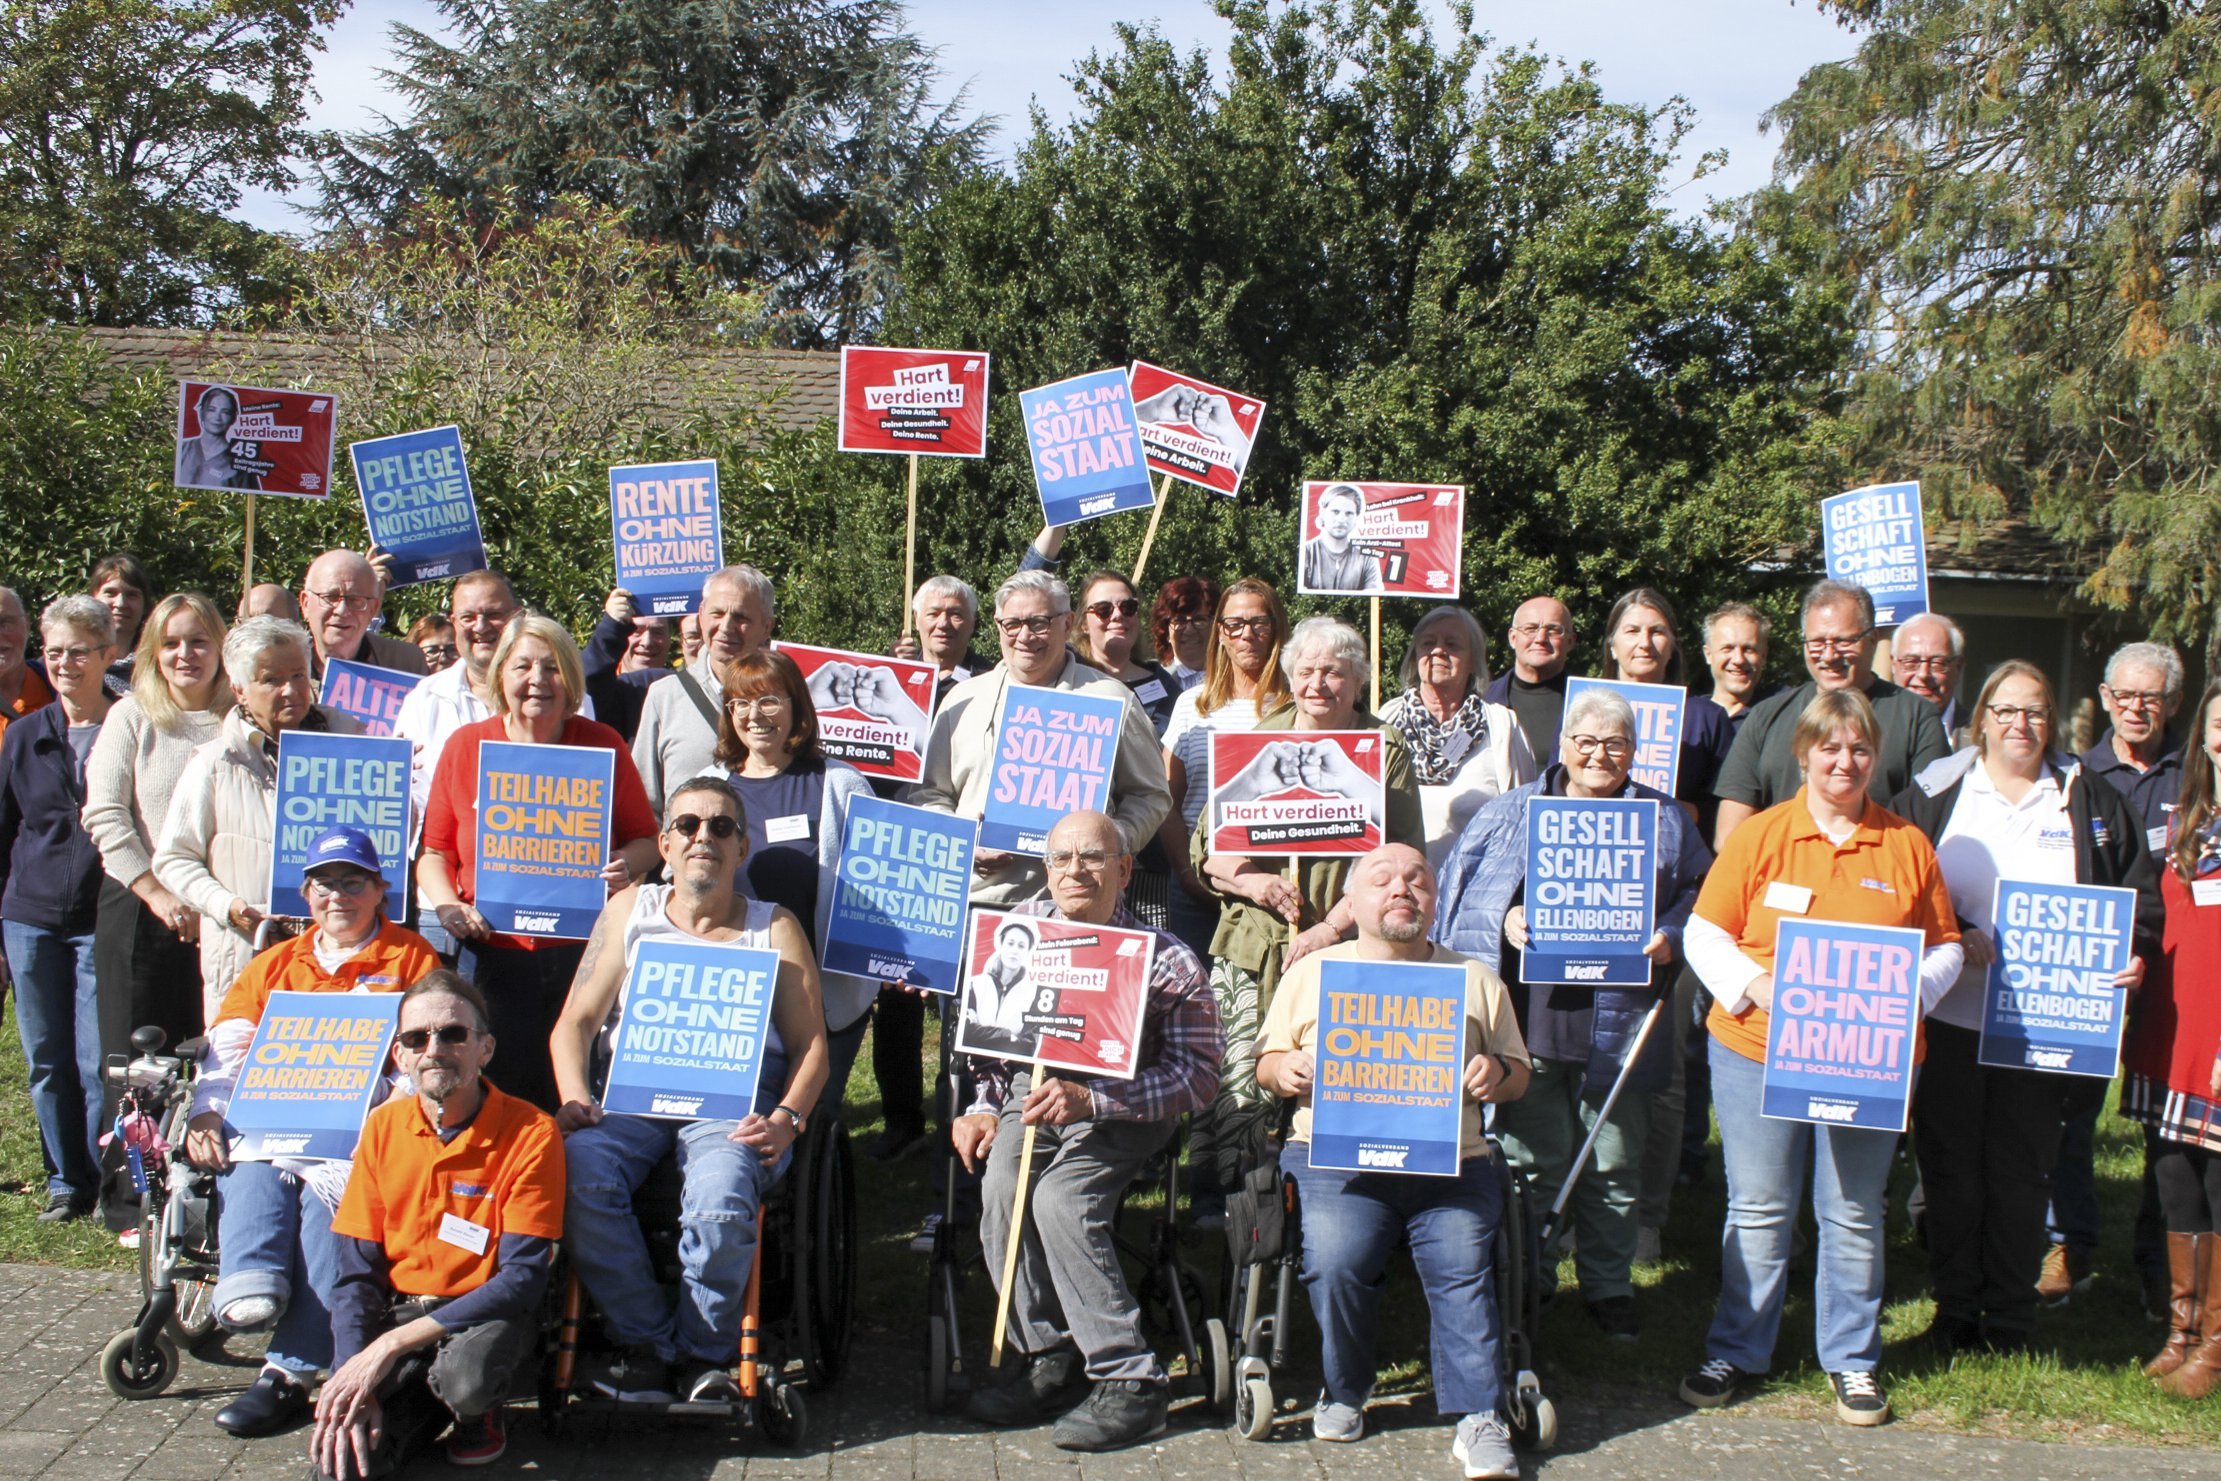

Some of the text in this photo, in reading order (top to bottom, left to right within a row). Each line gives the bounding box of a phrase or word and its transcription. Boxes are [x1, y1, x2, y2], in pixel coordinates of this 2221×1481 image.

[900, 368, 943, 386] Hart
[871, 388, 960, 404] verdient!
[1031, 383, 1125, 420] JA ZUM
[234, 427, 298, 438] verdient!
[240, 416, 270, 426] Hart
[1033, 403, 1131, 447] SOZIAL
[916, 432, 939, 440] Rente.
[1164, 434, 1231, 463] verdient!
[231, 441, 257, 458] 45
[1039, 431, 1135, 481] STAAT
[1144, 445, 1206, 473] eine Arbeit.
[362, 446, 460, 490] PFLEGE
[371, 478, 465, 512] OHNE
[617, 478, 712, 518] RENTE
[1079, 497, 1116, 516] VdK
[374, 502, 470, 537] NOTSTAND
[1364, 512, 1394, 524] Hart
[1830, 493, 1912, 531] GESELL
[402, 524, 471, 543] SOZIALSTAAT
[620, 516, 713, 541] OHNE
[1358, 525, 1424, 536] verdient!
[1832, 520, 1913, 555] SCHAFT
[621, 539, 715, 567] KÜRZUNG
[1834, 545, 1916, 574] OHNE
[416, 564, 450, 579] VdK
[644, 565, 715, 576] SOZIALSTAAT
[1389, 555, 1402, 581] 1
[653, 601, 688, 613] VdK
[327, 672, 416, 720] ALTE
[1008, 705, 1114, 736] JA ZUM
[823, 722, 909, 746] verdient!
[846, 744, 891, 760] Rente.
[1003, 726, 1105, 773] SOZIAL
[284, 755, 404, 797] PFLEGE
[994, 763, 1103, 813] STAAT
[486, 771, 603, 808] TEILHABE
[284, 797, 402, 827] OHNE
[485, 805, 602, 838] OHNE
[1227, 804, 1363, 819] Hart verdient!
[1252, 822, 1362, 841] Deine Gesundheit.
[1538, 810, 1646, 846] GESELL
[483, 834, 600, 866] BARRIEREN
[850, 816, 968, 872] PFLEGE
[291, 855, 306, 864] ZUM
[509, 863, 600, 879] SOZIALSTAAT
[1537, 847, 1645, 879] SCHAFT
[847, 856, 964, 899] OHNE
[841, 881, 959, 927] NOTSTAND
[1536, 882, 1644, 907] OHNE
[514, 916, 559, 932] VdK
[840, 909, 956, 938] JA ZUM SOZIALSTAAT
[1535, 908, 1643, 930] ELLENBOGEN
[2006, 892, 2120, 936] GESELL
[1560, 933, 1641, 942] SOZIALSTAAT
[2003, 929, 2119, 970] SCHAFT
[867, 959, 913, 979] VdK
[1031, 954, 1066, 967] Hart
[1565, 966, 1608, 979] VdK
[1783, 936, 1912, 994] ALTER
[636, 961, 767, 1006] PFLEGE
[1029, 970, 1104, 986] verdient!
[2001, 964, 2115, 998] OHNE
[1037, 989, 1055, 1013] 8
[1328, 992, 1457, 1030] TEILHABE
[1780, 988, 1907, 1025] OHNE
[1997, 990, 2113, 1022] ELLENBOGEN
[632, 998, 760, 1032] OHNE
[1024, 1015, 1054, 1023] Stunden
[1069, 1017, 1084, 1026] Tag
[2022, 1016, 2110, 1033] SOZIALSTAAT
[266, 1017, 389, 1041] TEILHABE
[1039, 1026, 1081, 1040] sind genug
[255, 1043, 379, 1065] OHNE
[624, 1025, 755, 1060] NOTSTAND
[1325, 1028, 1456, 1062] OHNE
[1775, 1018, 1905, 1068] ARMUT
[632, 1054, 650, 1063] ZUM
[653, 1056, 750, 1072] SOZIALSTAAT
[2025, 1050, 2072, 1068] VdK
[243, 1068, 370, 1089] BARRIEREN
[1323, 1060, 1454, 1093] BARRIEREN
[1805, 1064, 1901, 1082] SOZIALSTAAT
[268, 1092, 362, 1100] SOZIALSTAAT
[651, 1099, 703, 1115] VdK
[1322, 1091, 1452, 1107] JA ZUM SOZIALSTAAT
[1808, 1102, 1858, 1122] VdK
[261, 1139, 310, 1153] VdK
[1358, 1150, 1408, 1168] VdK
